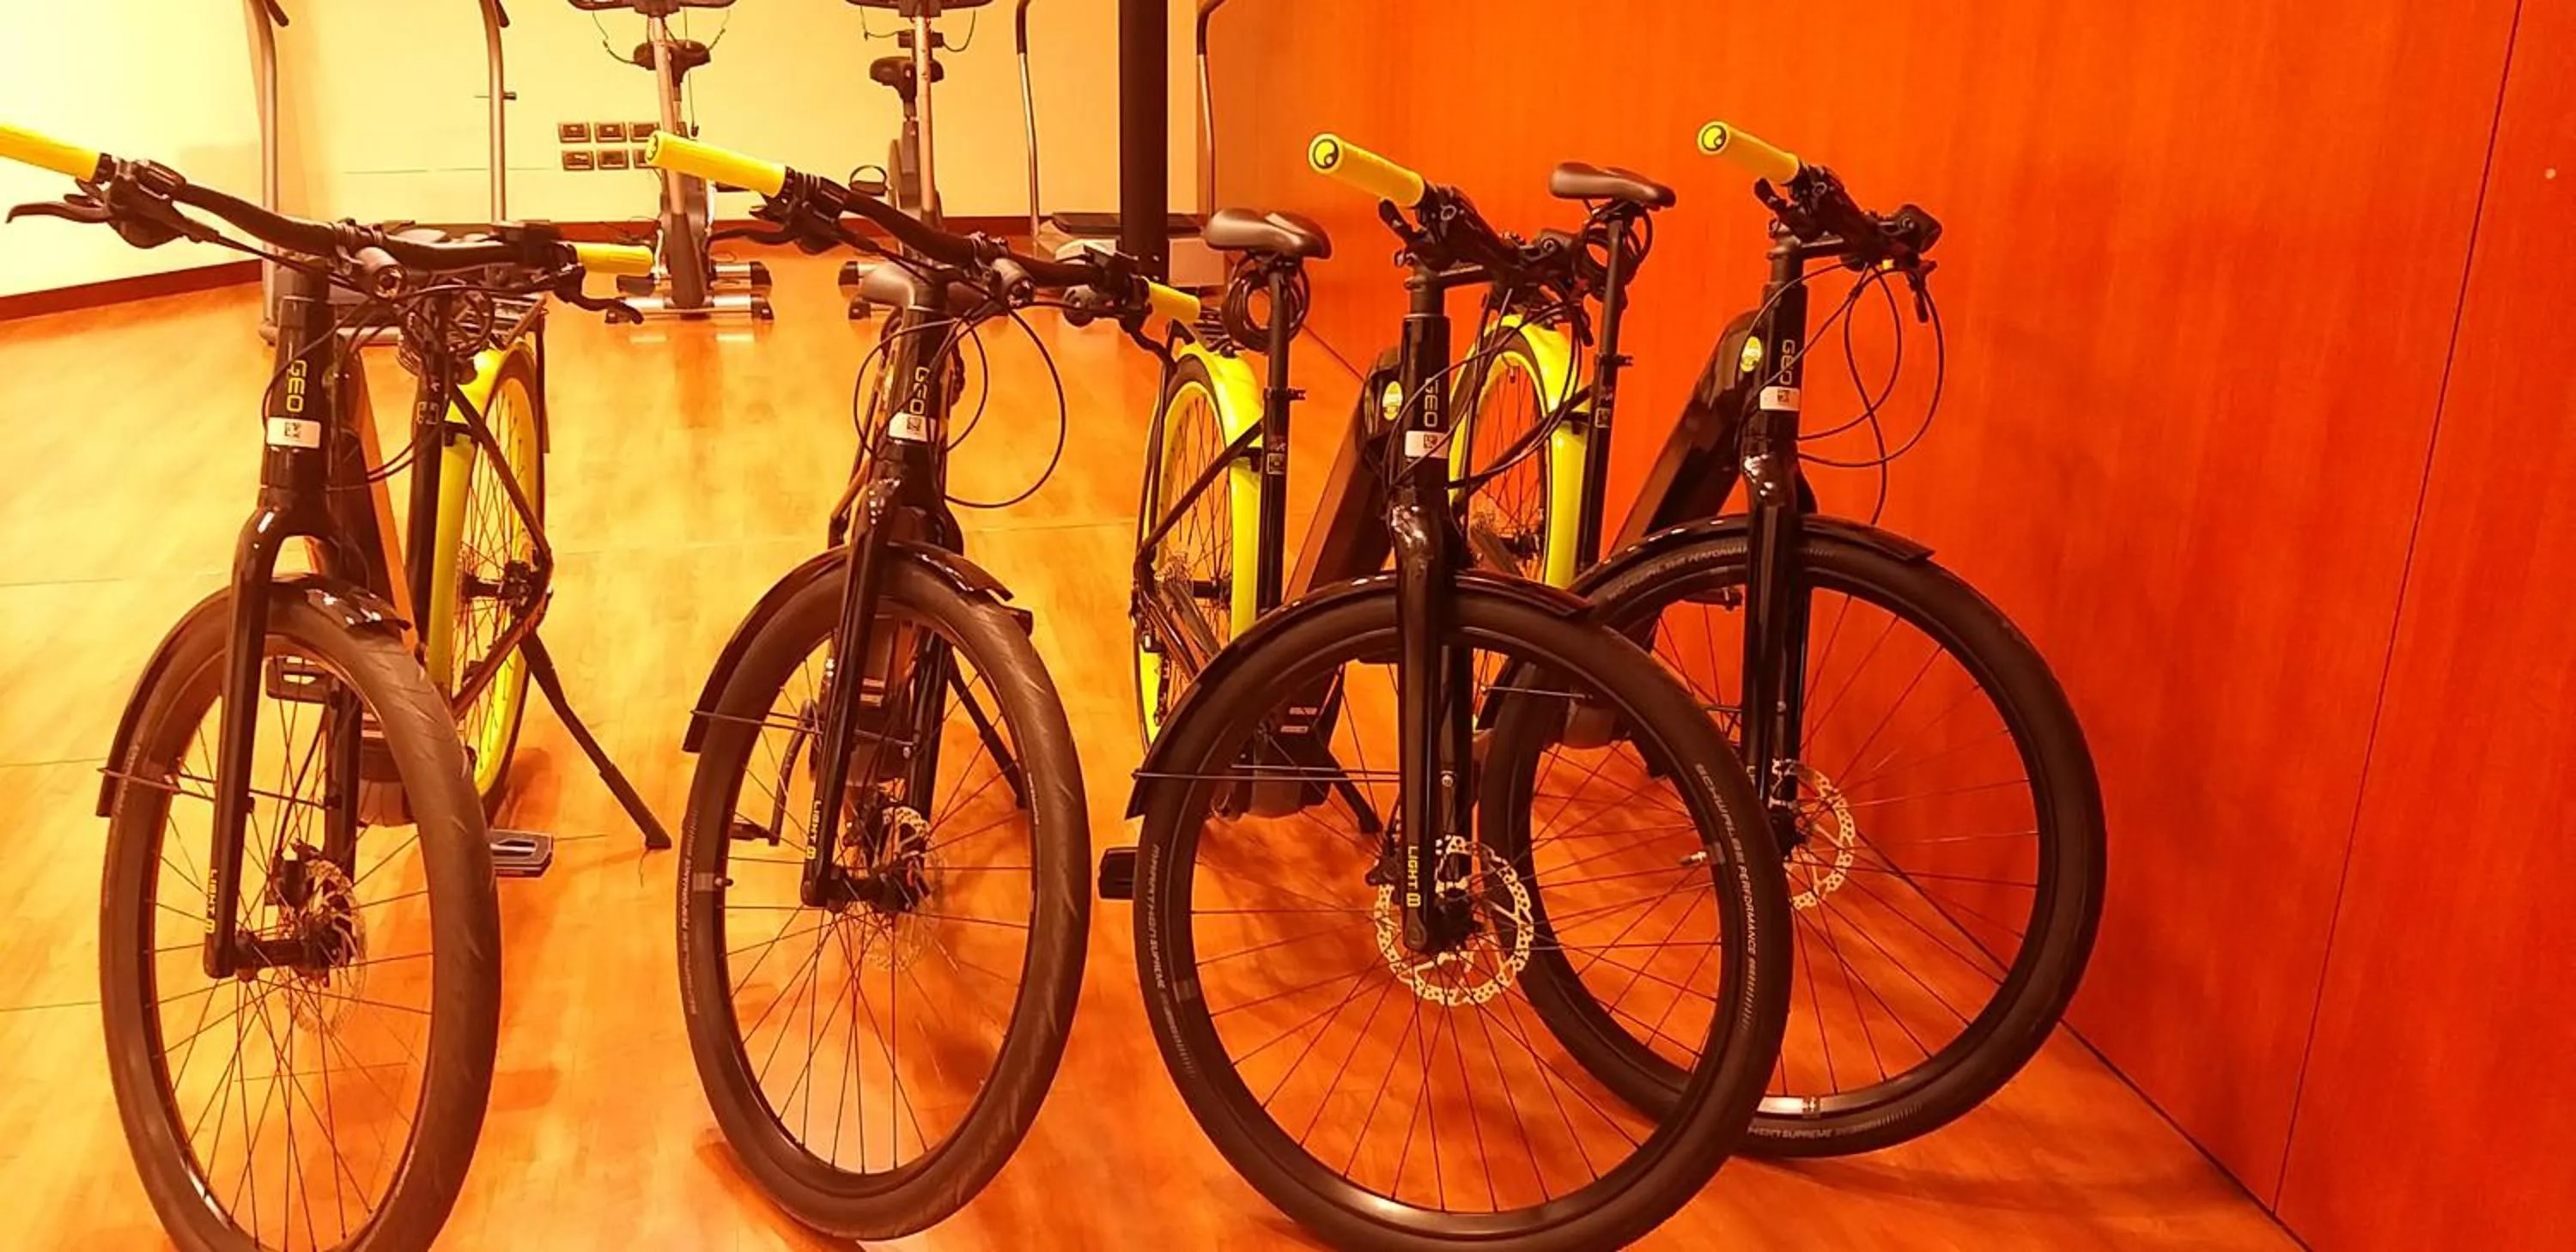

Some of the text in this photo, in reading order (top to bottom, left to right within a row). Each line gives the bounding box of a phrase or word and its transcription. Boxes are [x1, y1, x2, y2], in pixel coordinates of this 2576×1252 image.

[286, 359, 307, 413] GEO
[1780, 339, 1795, 386] GEO
[909, 366, 930, 415] GEO
[1424, 378, 1439, 428] GEO
[809, 799, 822, 843] LIGHT
[1407, 846, 1419, 890] LIGHT
[1737, 865, 1757, 956] PERFORMANCE
